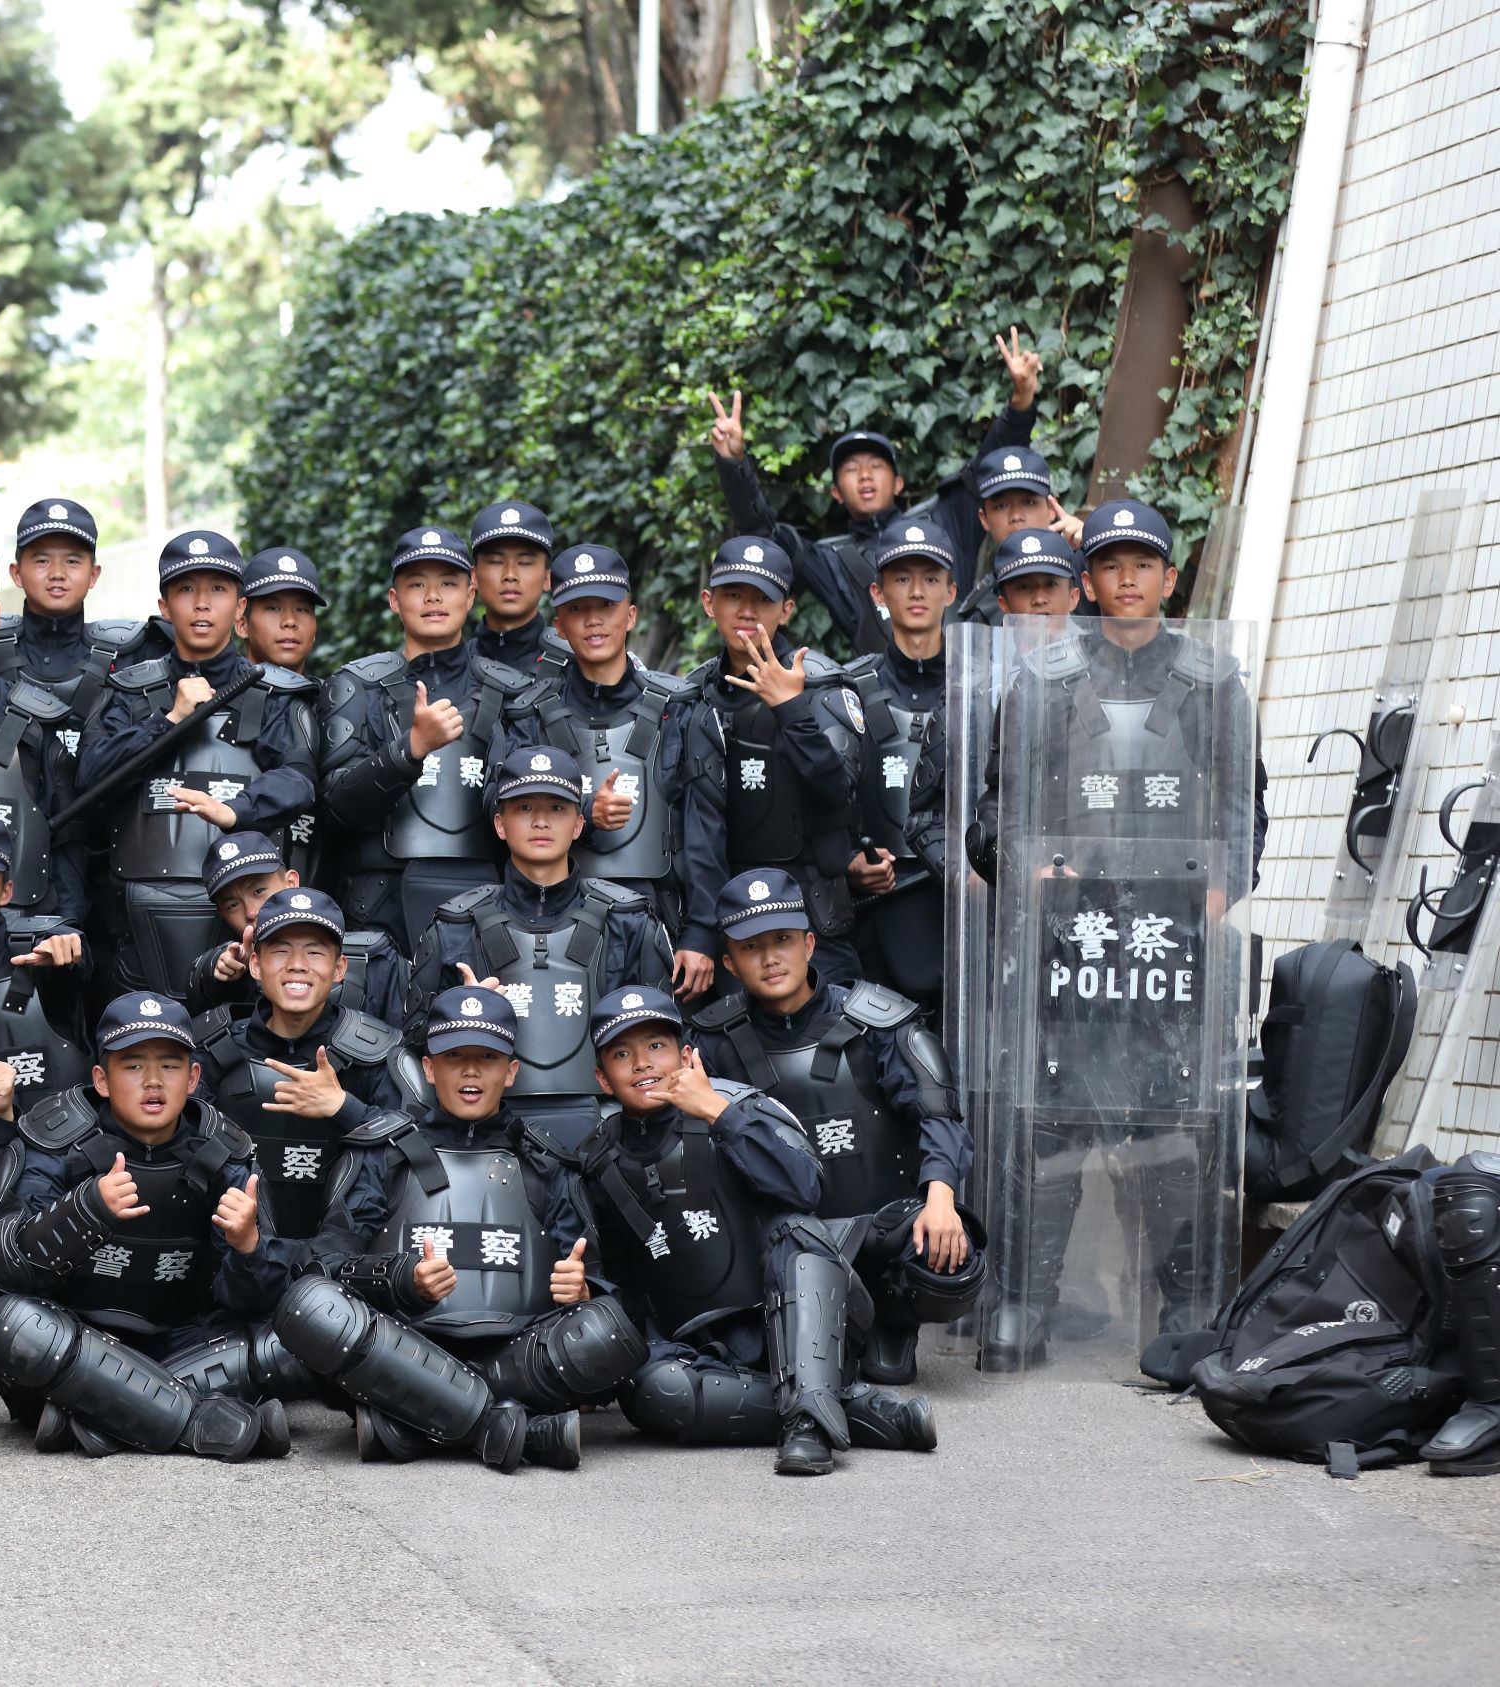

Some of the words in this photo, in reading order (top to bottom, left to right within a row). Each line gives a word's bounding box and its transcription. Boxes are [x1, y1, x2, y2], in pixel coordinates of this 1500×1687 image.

[417, 754, 486, 788] 警察
[740, 757, 767, 790] 察
[882, 755, 910, 789] 警
[1081, 774, 1181, 810] 警察
[1067, 911, 1181, 964] 警察
[504, 981, 585, 1019] 警察
[1049, 964, 1193, 1002] POLICE
[815, 1117, 856, 1157] 察
[89, 1243, 194, 1283] 警察
[411, 1226, 522, 1268] 警察
